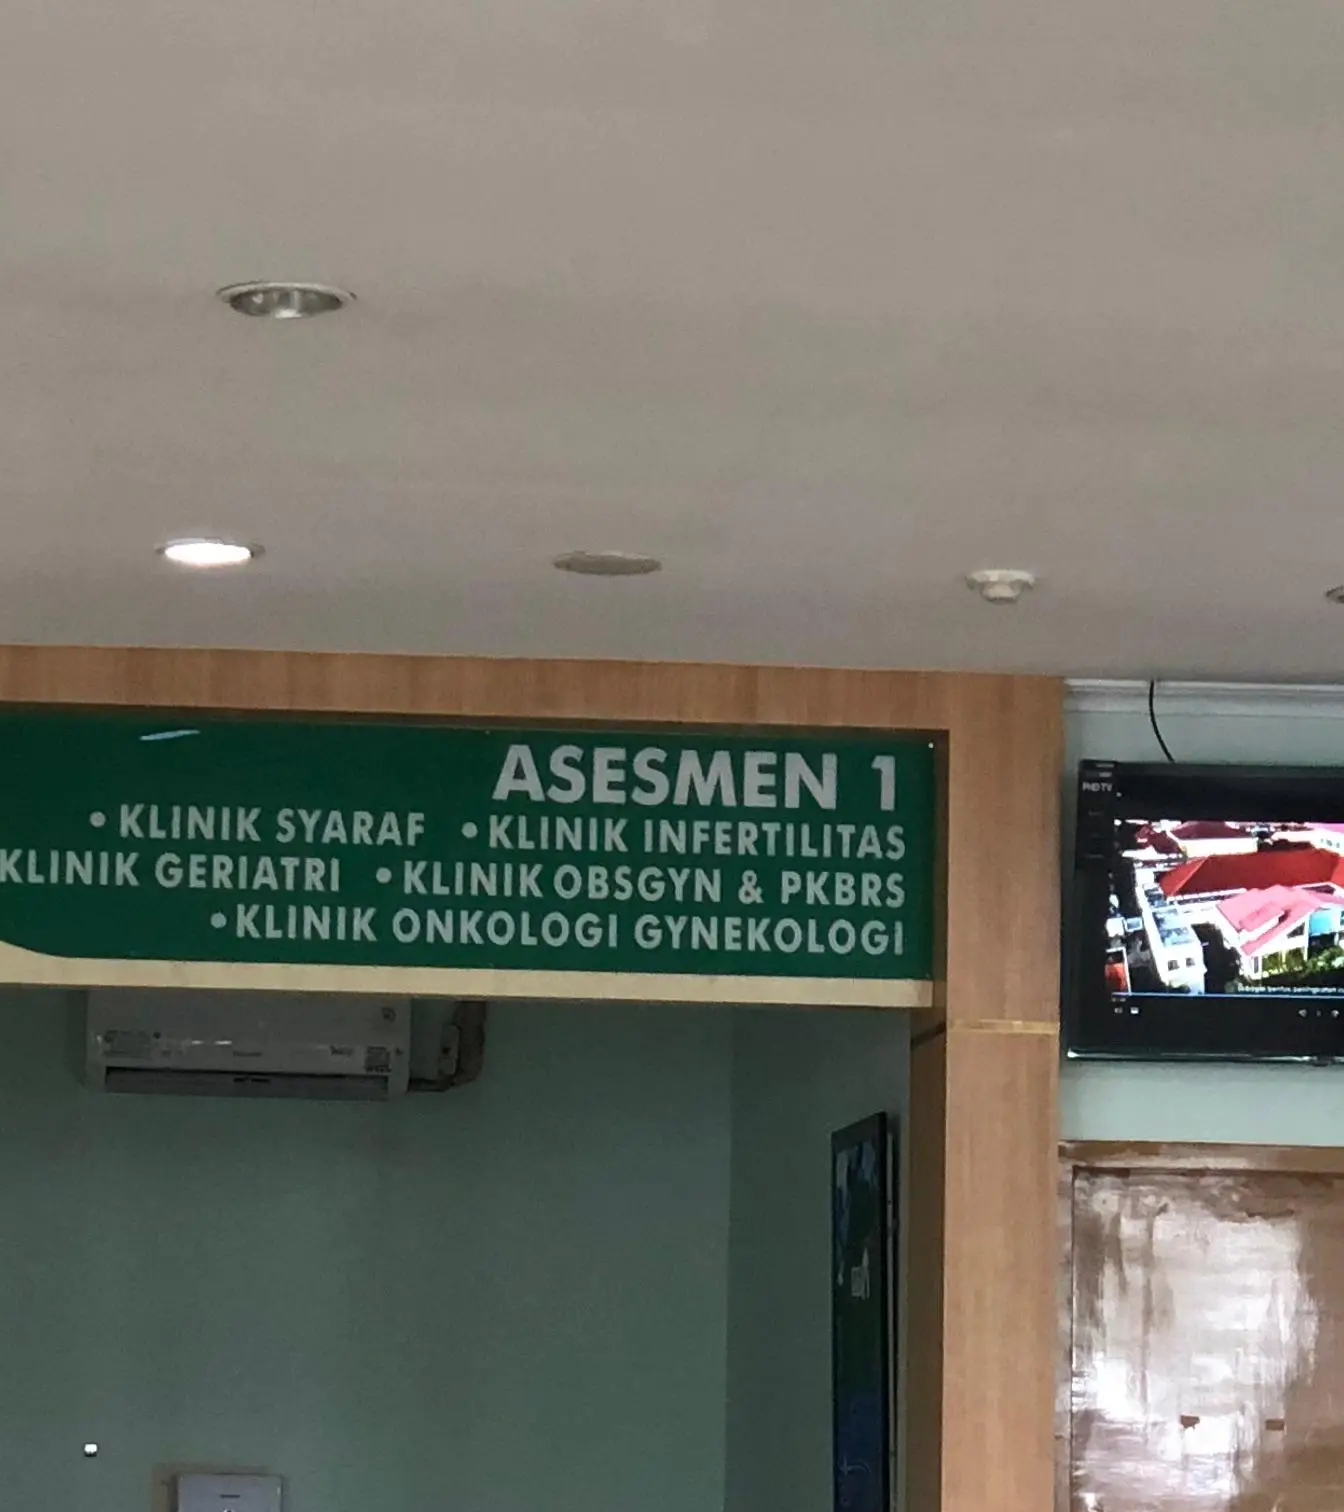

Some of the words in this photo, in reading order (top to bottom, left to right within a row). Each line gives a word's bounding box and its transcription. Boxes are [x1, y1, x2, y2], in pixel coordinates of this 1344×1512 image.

[492, 744, 838, 810] ASESMEN
[871, 756, 896, 811] 1
[120, 804, 261, 842] KLINIK
[276, 808, 425, 846] SYARAF
[489, 814, 629, 853] KLINIK
[644, 819, 905, 861] INFERTILITAS
[155, 852, 341, 892] GERIATRI
[404, 861, 544, 899] KLINIK
[554, 865, 721, 903] OBSGYN
[739, 869, 764, 905] &
[781, 871, 905, 908] PKBRS
[236, 904, 377, 942] KLINIK
[392, 907, 617, 948] ONKOLOGI
[634, 914, 904, 955] GYNEKOLOGI
